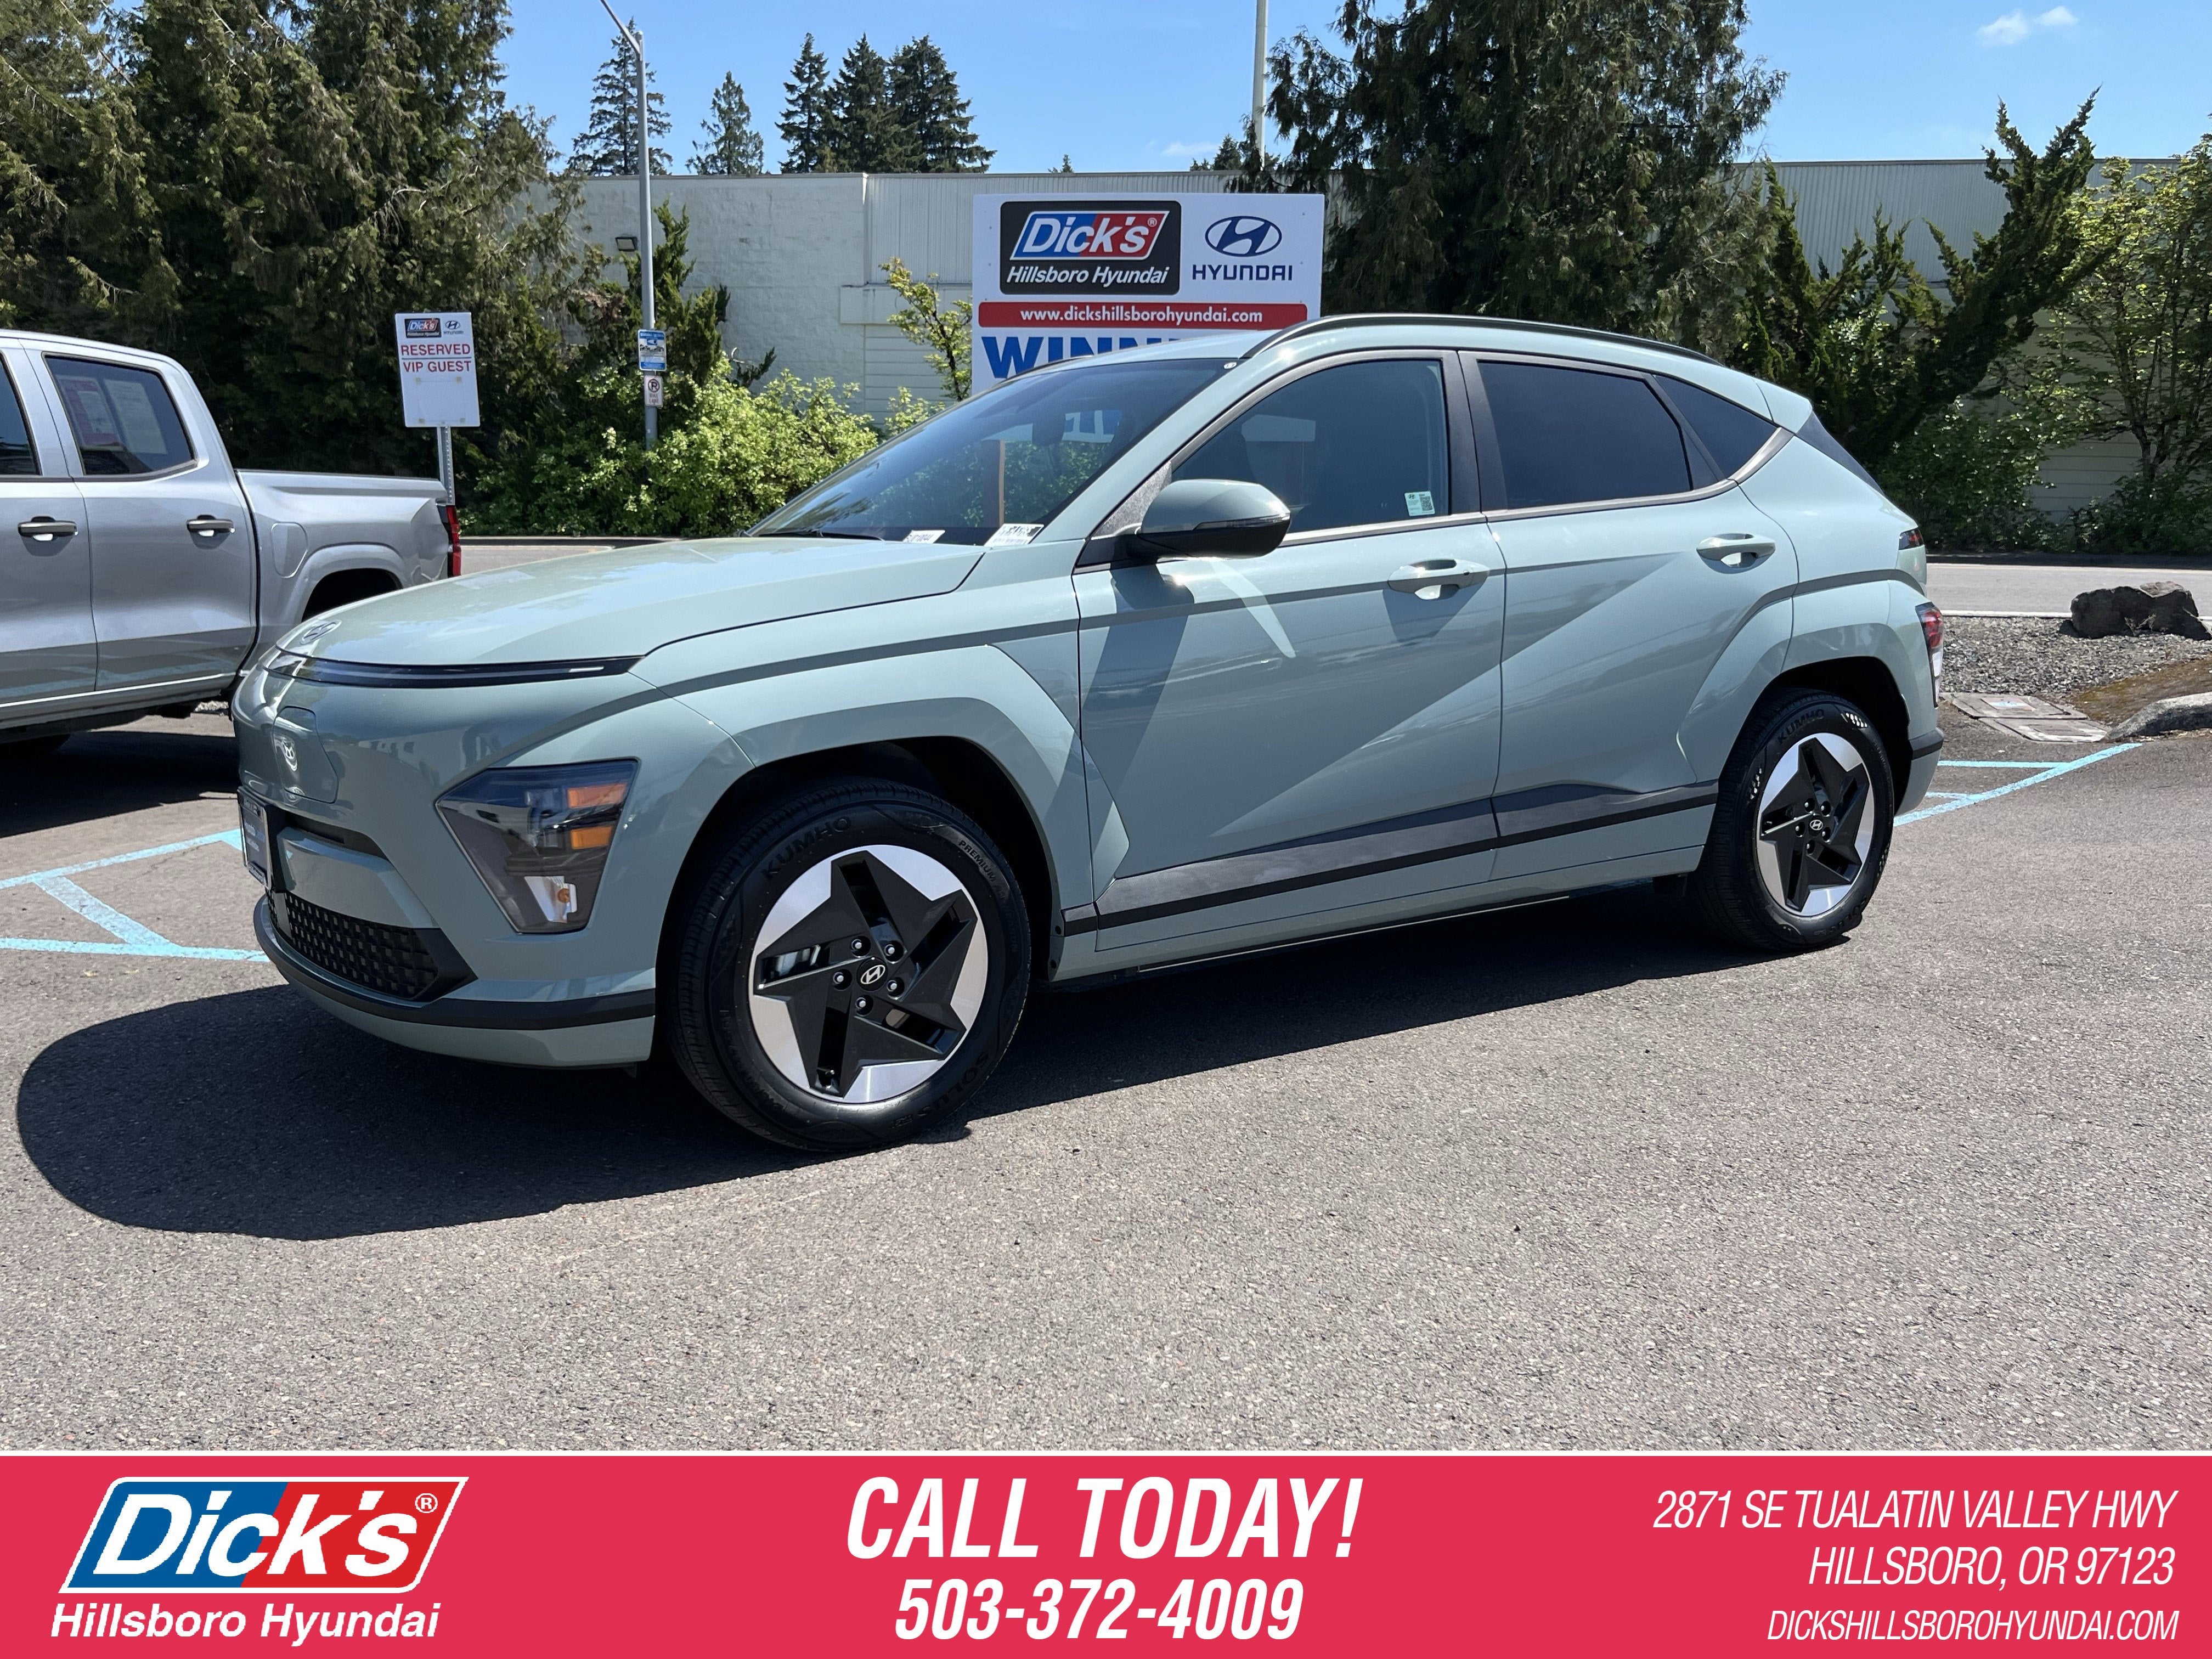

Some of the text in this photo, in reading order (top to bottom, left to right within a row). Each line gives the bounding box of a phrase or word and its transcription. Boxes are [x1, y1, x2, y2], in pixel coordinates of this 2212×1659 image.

[1022, 216, 1149, 253] Dick's
[1006, 266, 1170, 288] Hillsboro Hyundai
[1192, 264, 1293, 281] HYUNDAI
[1020, 304, 1263, 326] www.dickshillsborohyundai.com
[400, 343, 471, 356] RESERVED
[403, 360, 472, 373] VIP GUEST
[761, 816, 852, 879] KUMHO
[958, 839, 997, 882] PREMIUM
